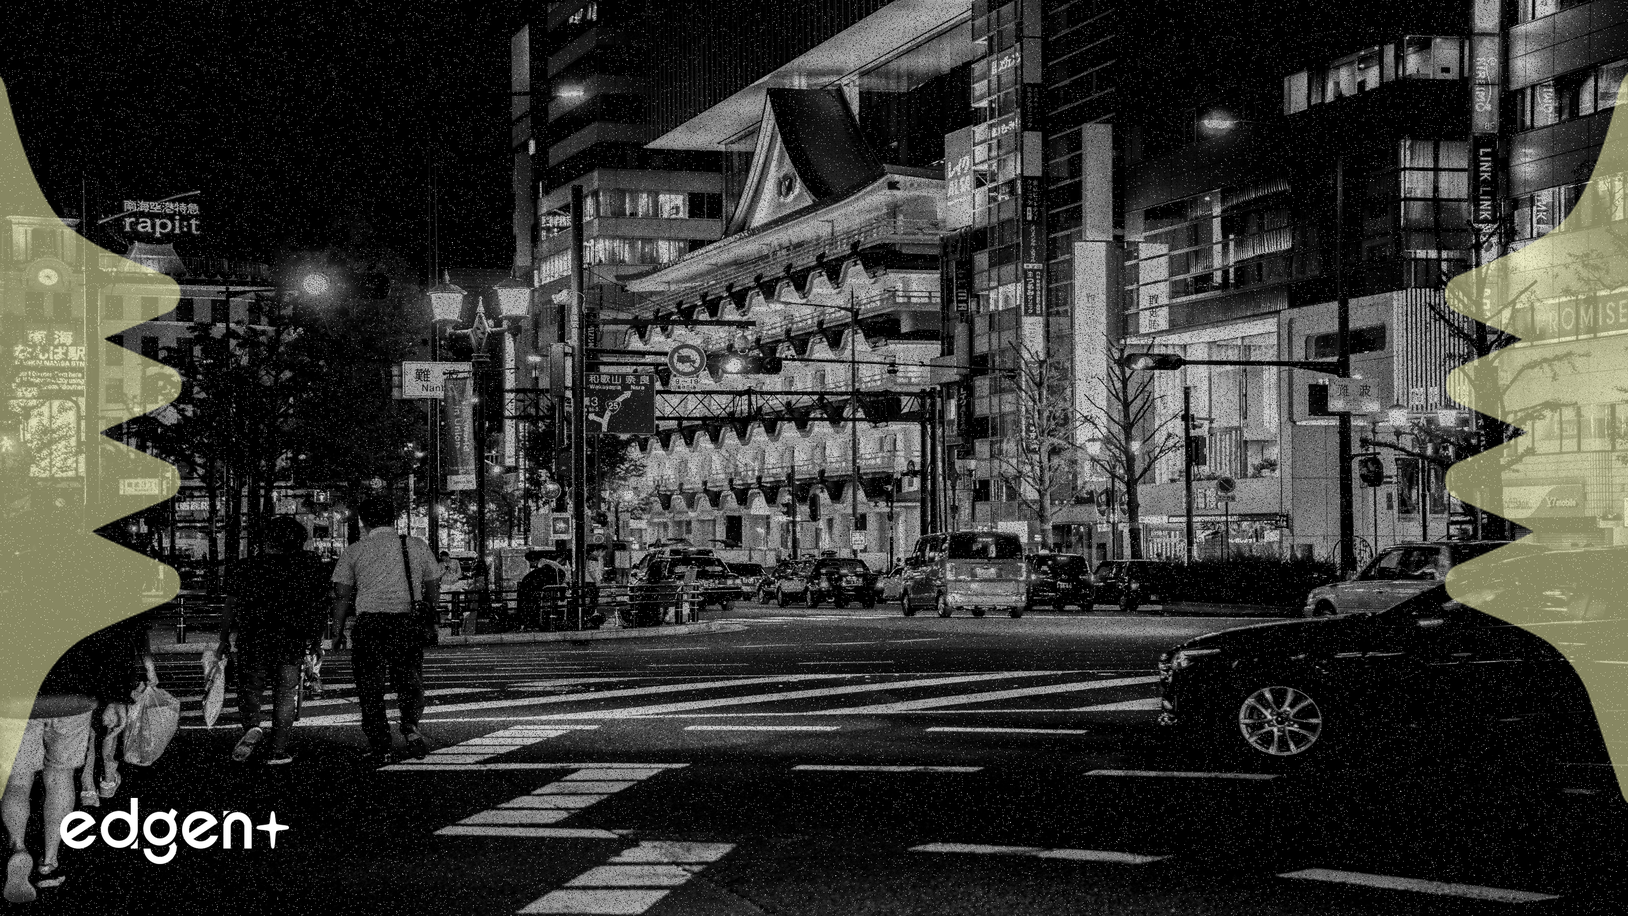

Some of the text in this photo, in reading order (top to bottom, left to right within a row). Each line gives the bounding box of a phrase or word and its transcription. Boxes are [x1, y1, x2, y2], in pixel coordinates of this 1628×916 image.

[1479, 148, 1492, 181] LINK
[123, 199, 200, 215] 南海空港特急
[1479, 187, 1492, 220] LINK
[588, 374, 650, 385] 和歌山 奈良
[1335, 384, 1372, 398] 難波
[607, 401, 619, 410] 25
[454, 417, 463, 450] Union
